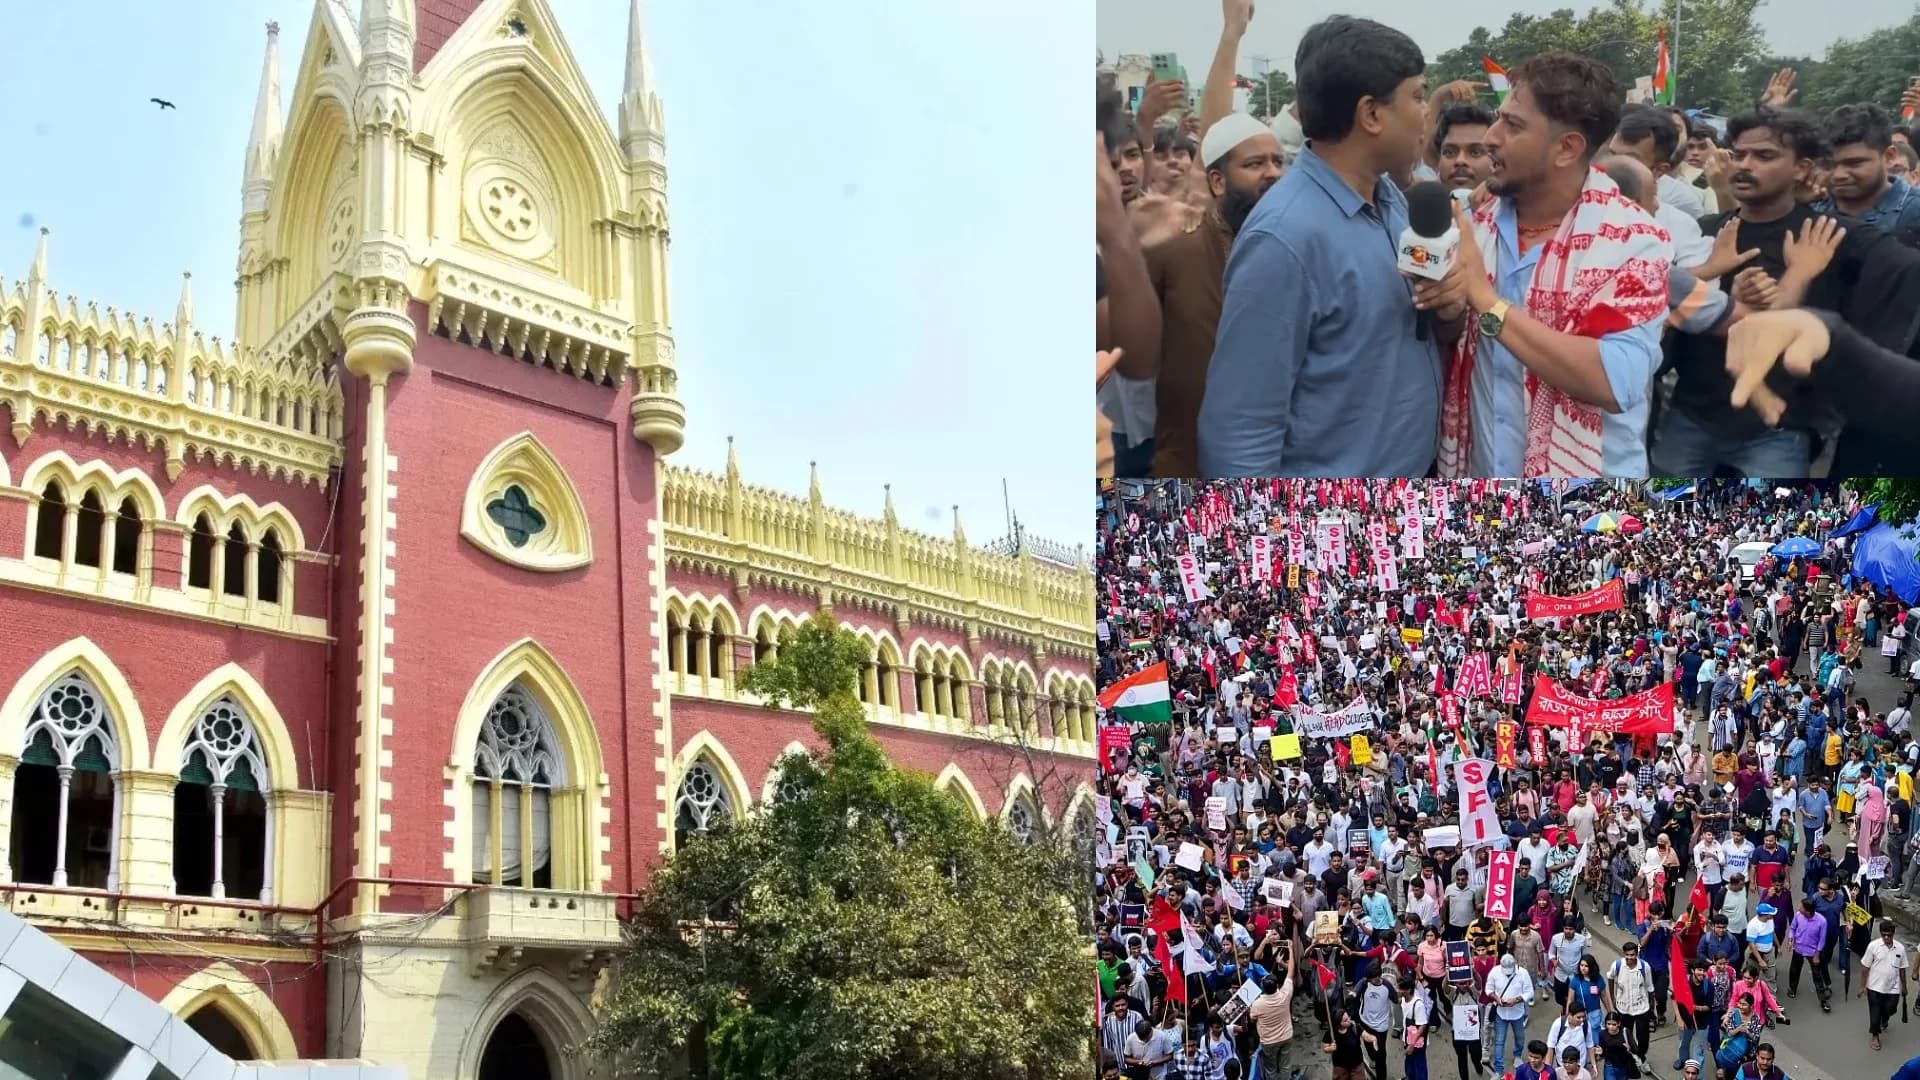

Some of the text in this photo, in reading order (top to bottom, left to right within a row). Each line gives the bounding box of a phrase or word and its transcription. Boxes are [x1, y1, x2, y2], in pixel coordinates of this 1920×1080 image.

[1255, 539, 1266, 578] SFI
[1329, 527, 1340, 563] SFI
[1181, 558, 1198, 599] SFI
[1458, 659, 1475, 694] AISA
[1499, 724, 1512, 765] RYA
[1463, 762, 1487, 839] SFI
[1490, 852, 1511, 913] AISA
